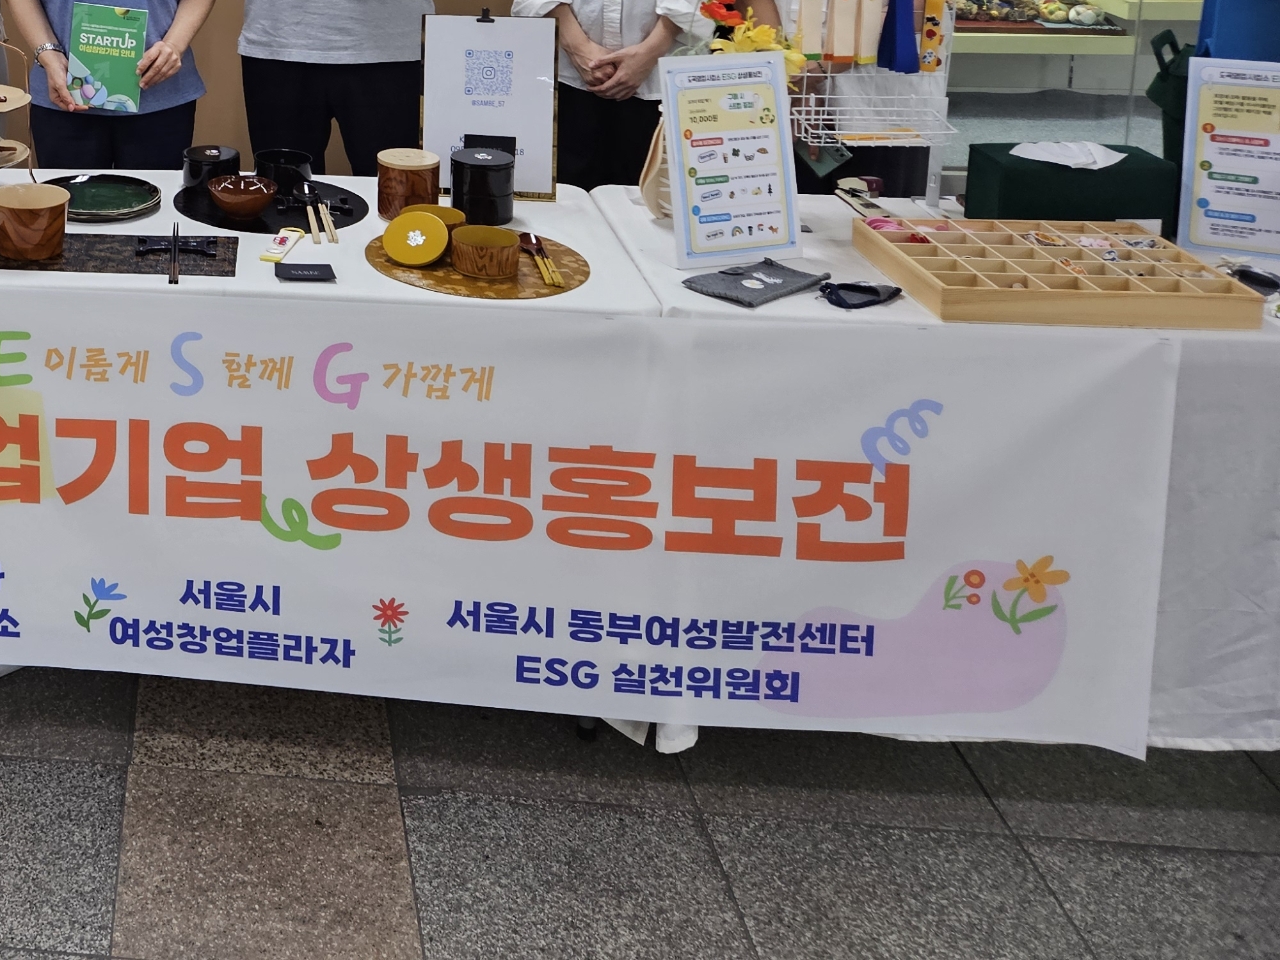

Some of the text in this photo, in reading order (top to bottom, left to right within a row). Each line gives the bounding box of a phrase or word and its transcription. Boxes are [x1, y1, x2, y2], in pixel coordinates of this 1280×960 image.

[79, 32, 136, 50] STARTUP
[722, 73, 737, 81] ESG
[689, 114, 718, 125] 10,000원
[43, 345, 150, 385] 이롭게
[170, 331, 204, 397] S
[221, 350, 294, 391] 함께
[312, 342, 370, 410] G
[382, 361, 495, 403] 가깝게
[306, 431, 911, 562] 상생홍보전
[179, 578, 282, 616] 서울시
[108, 614, 357, 669] 여성창업플라자
[446, 599, 876, 657] 서울시 동부여성발전센터
[515, 654, 801, 704] ESG 실천위원회
